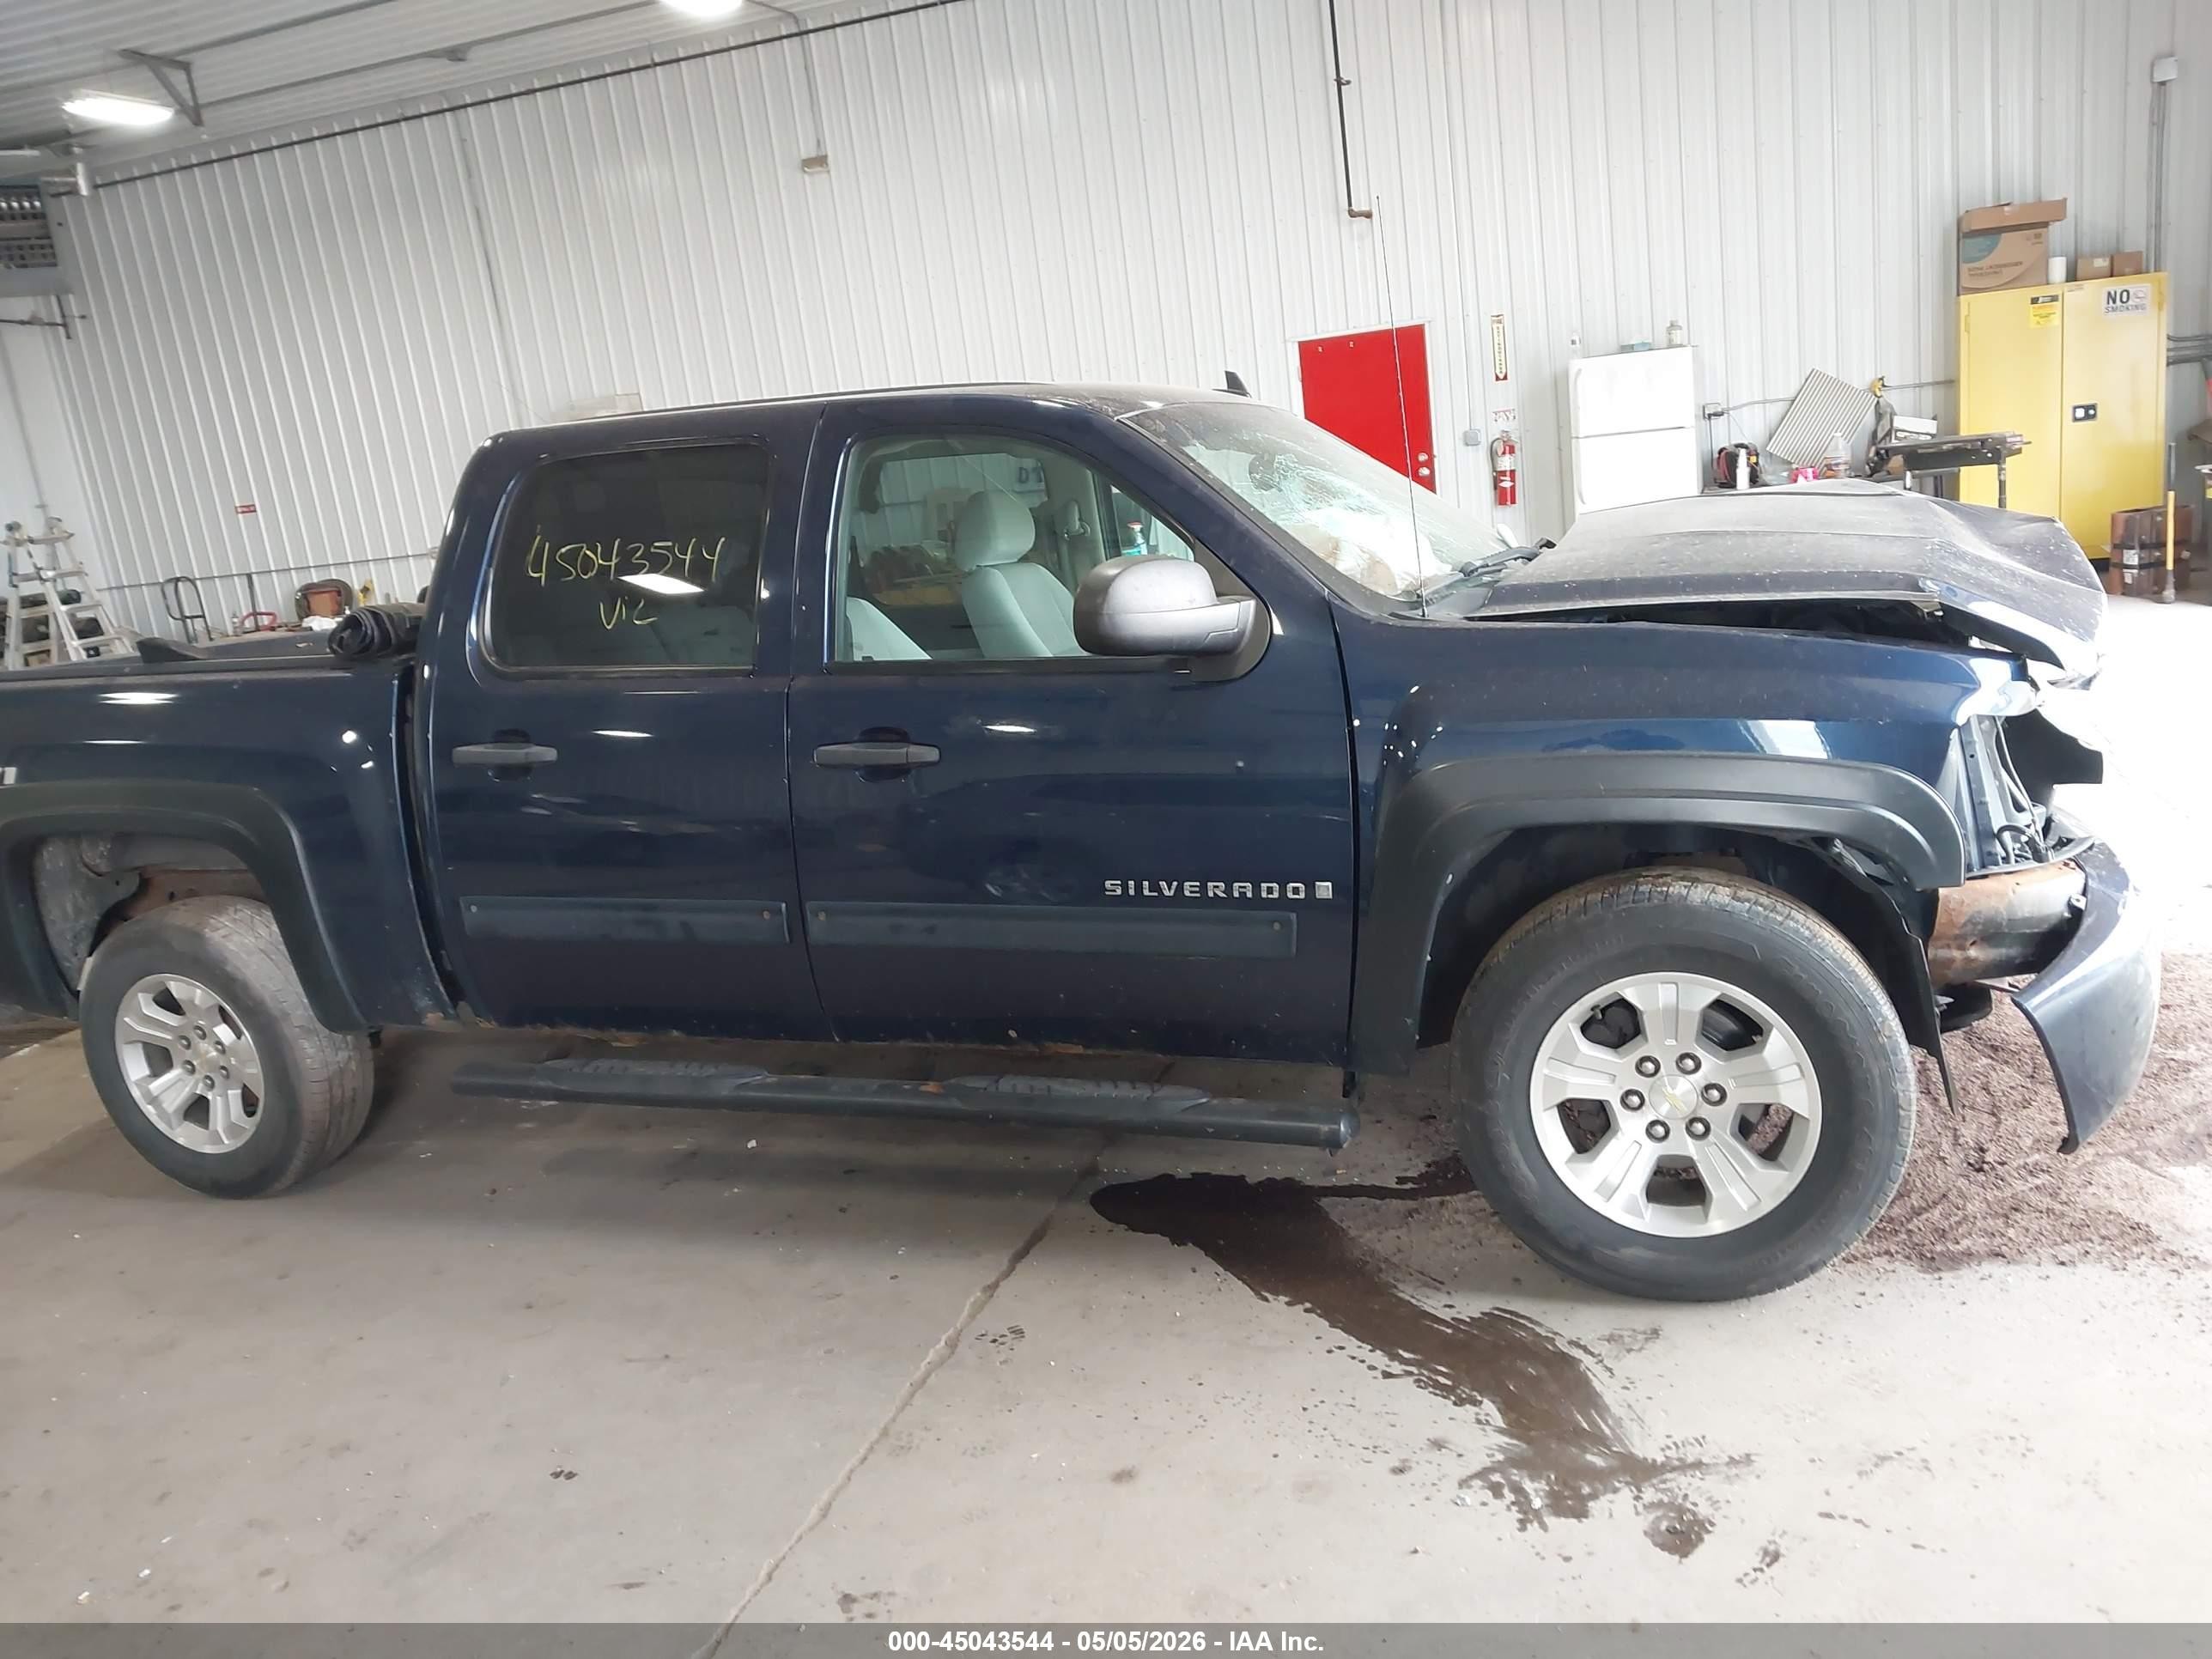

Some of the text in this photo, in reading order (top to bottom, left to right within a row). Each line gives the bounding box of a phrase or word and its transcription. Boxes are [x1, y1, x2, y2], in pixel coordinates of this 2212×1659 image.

[2106, 289, 2130, 305] NO
[2105, 302, 2147, 314] SMOKING
[526, 532, 726, 587] 45043544
[1104, 879, 1306, 899] SILVERADO
